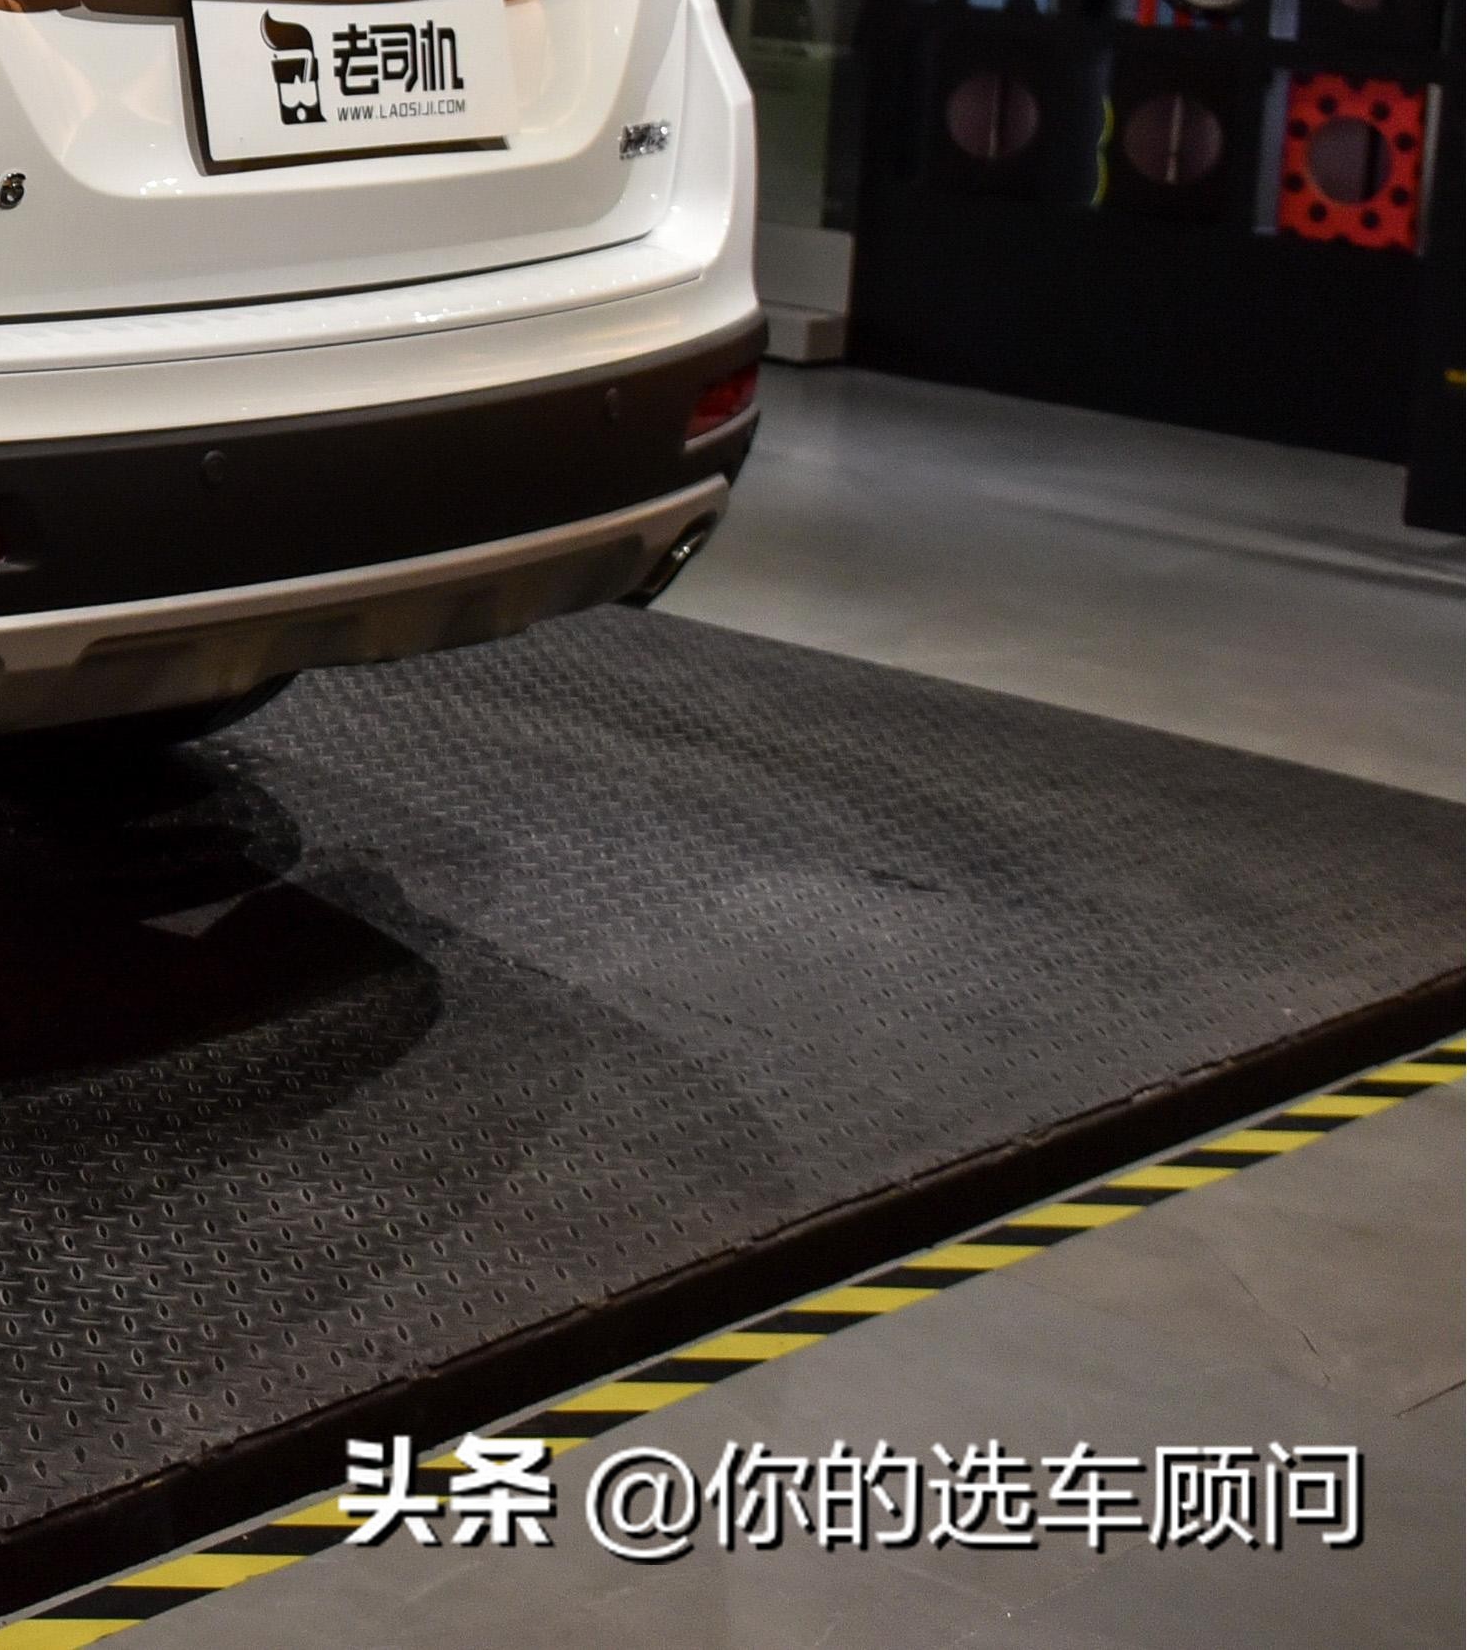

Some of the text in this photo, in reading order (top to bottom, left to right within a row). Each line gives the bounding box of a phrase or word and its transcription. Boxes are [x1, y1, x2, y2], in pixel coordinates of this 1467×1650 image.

[332, 19, 465, 96] 老司机
[337, 98, 466, 122] WWW.LAOSIJI.COM
